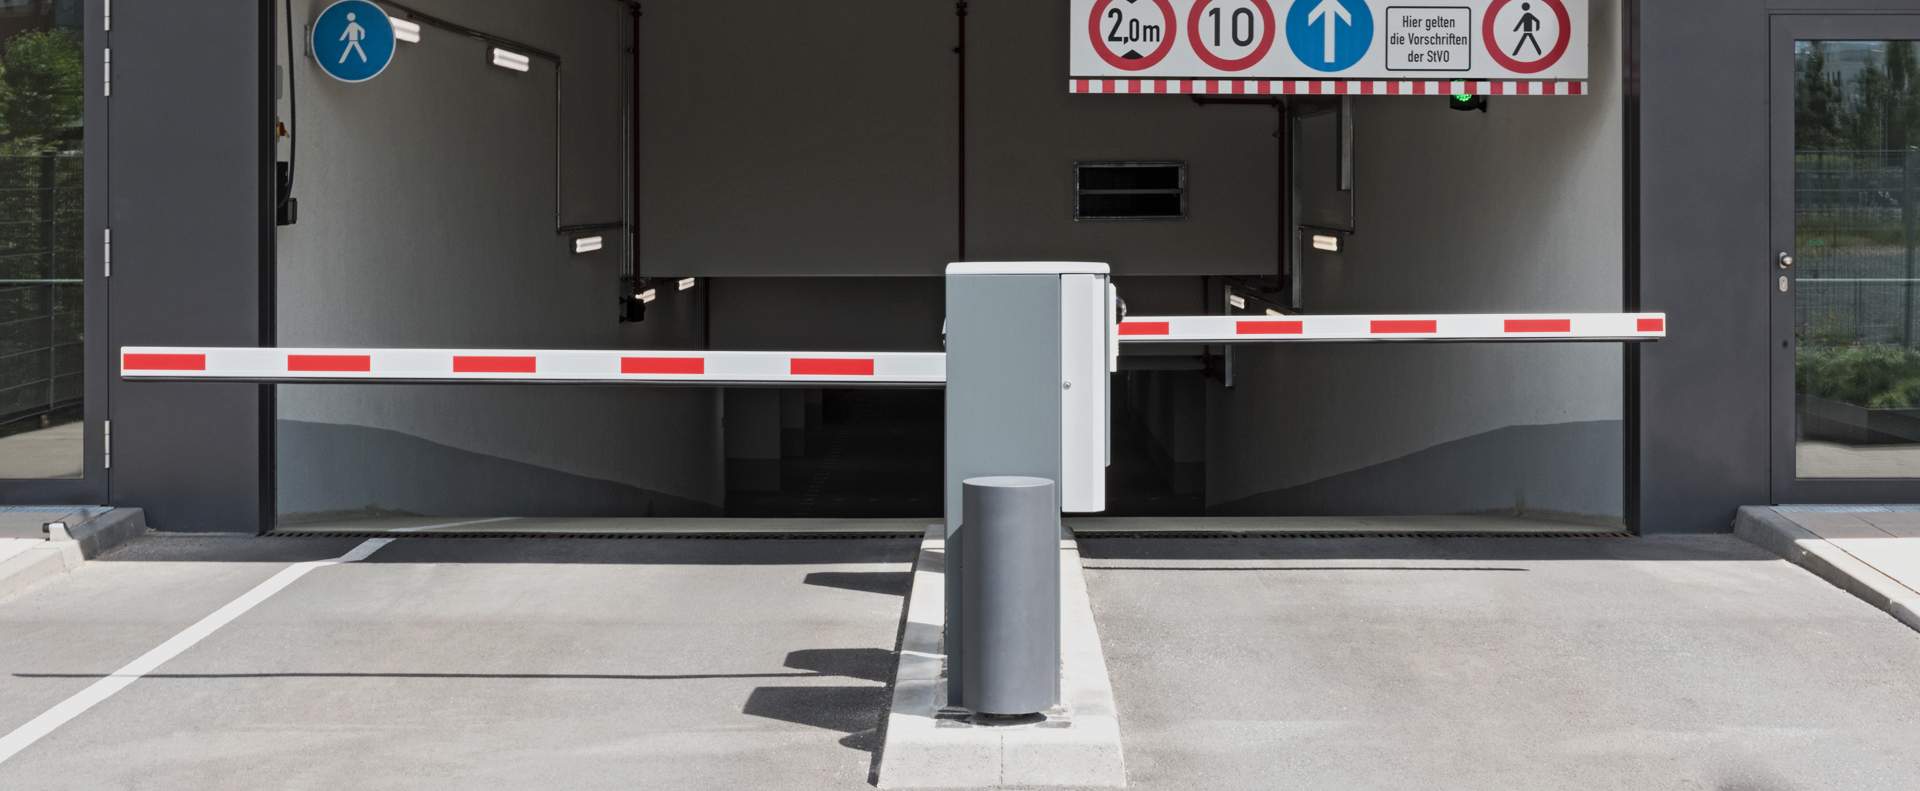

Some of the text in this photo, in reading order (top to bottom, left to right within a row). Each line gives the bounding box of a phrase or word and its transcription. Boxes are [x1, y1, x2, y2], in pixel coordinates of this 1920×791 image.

[1208, 7, 1255, 47] 10
[1402, 15, 1456, 31] Hier gelten
[1390, 32, 1468, 46] die Vorschriften
[1407, 50, 1450, 63] der StVO
